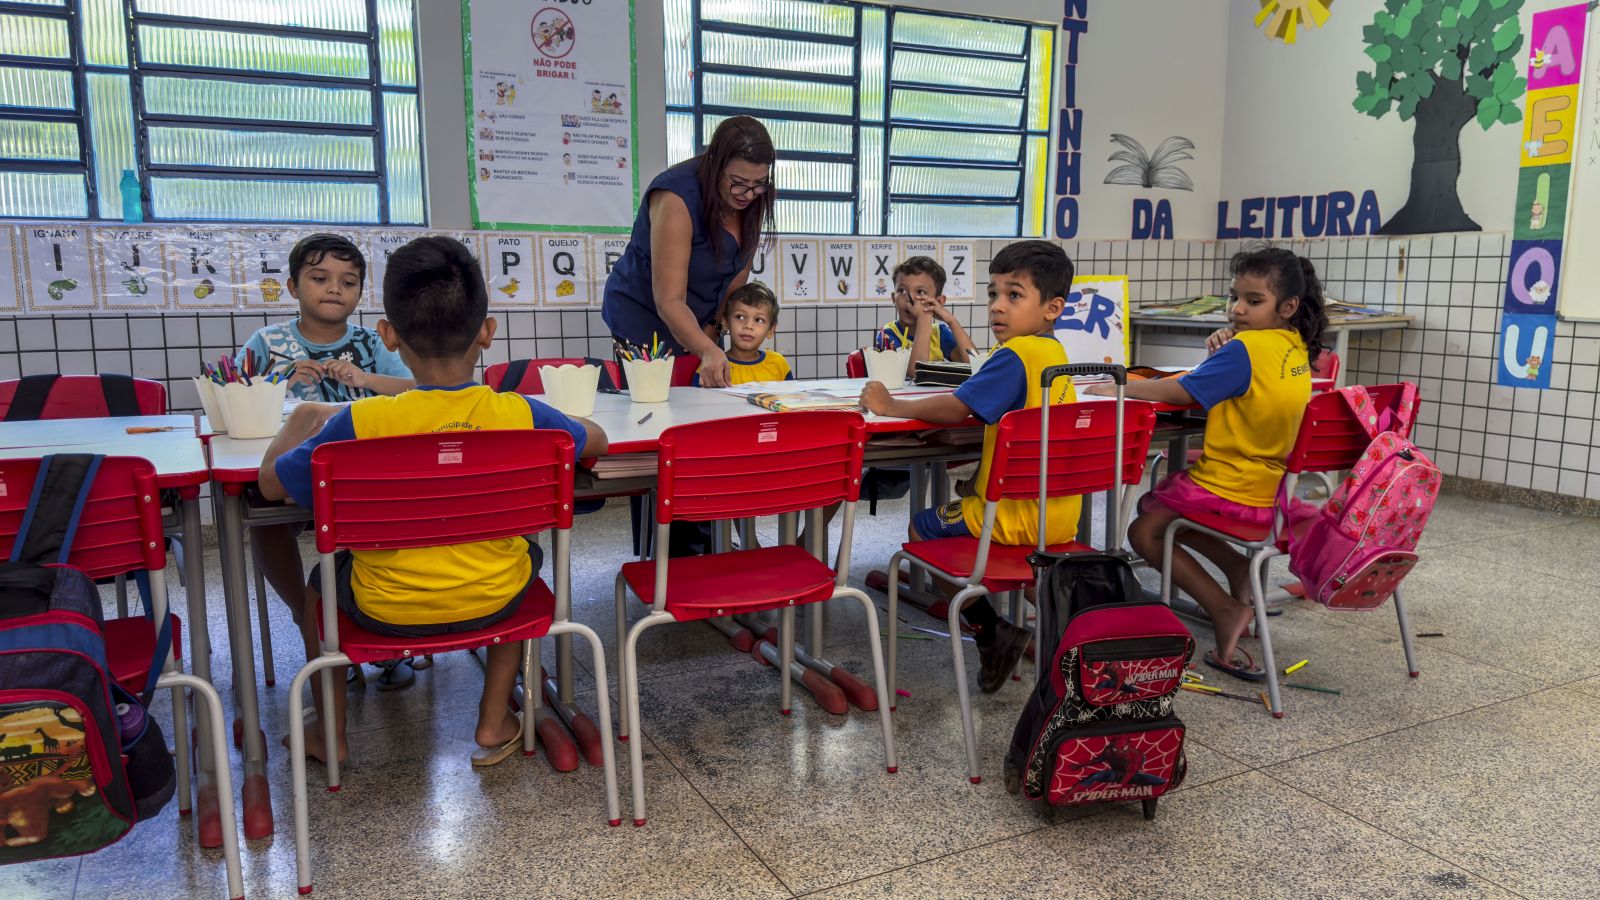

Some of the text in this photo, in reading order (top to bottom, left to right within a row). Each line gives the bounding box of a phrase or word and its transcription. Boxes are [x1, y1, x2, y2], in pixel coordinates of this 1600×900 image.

[533, 58, 577, 70] NÃO PODE
[536, 69, 569, 80] BRIGAR
[1503, 24, 1576, 379] A E I O U
[1131, 189, 1382, 240] DA LEITURA
[498, 238, 521, 246] PATO
[548, 239, 579, 247] QUEIJO
[604, 240, 626, 248] RATO
[53, 243, 63, 271] I
[190, 247, 218, 274] K
[260, 249, 282, 273] L
[501, 251, 521, 275] P
[552, 251, 576, 277] Q
[791, 253, 808, 275] V
[830, 256, 853, 277] W
[874, 255, 889, 276] X
[951, 256, 965, 276] Z
[1130, 668, 1178, 685] SPIDER-MAN
[1068, 785, 1152, 803] SPIDER-MAN
